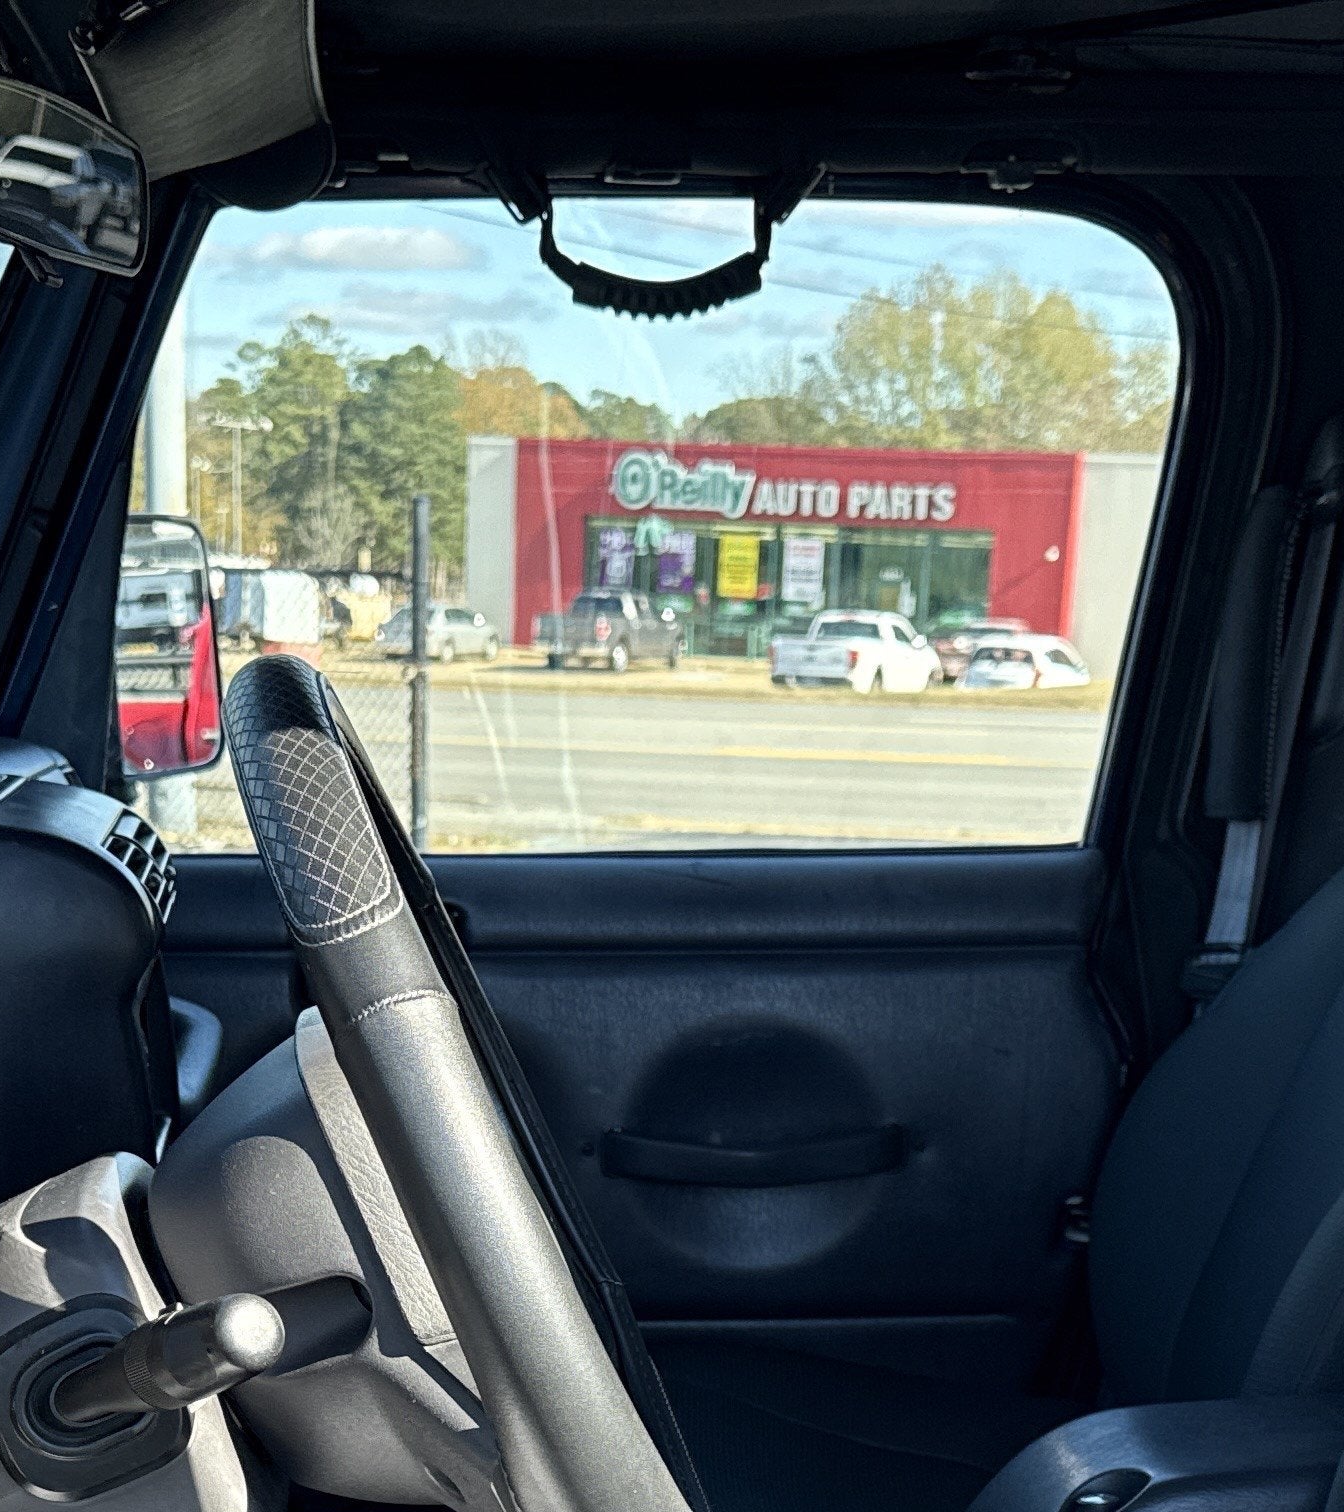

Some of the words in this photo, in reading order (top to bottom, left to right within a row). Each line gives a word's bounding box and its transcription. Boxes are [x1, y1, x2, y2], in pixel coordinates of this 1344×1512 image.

[614, 450, 756, 519] O'Reilly
[752, 478, 841, 518] AUTO
[846, 481, 955, 521] PARTS
